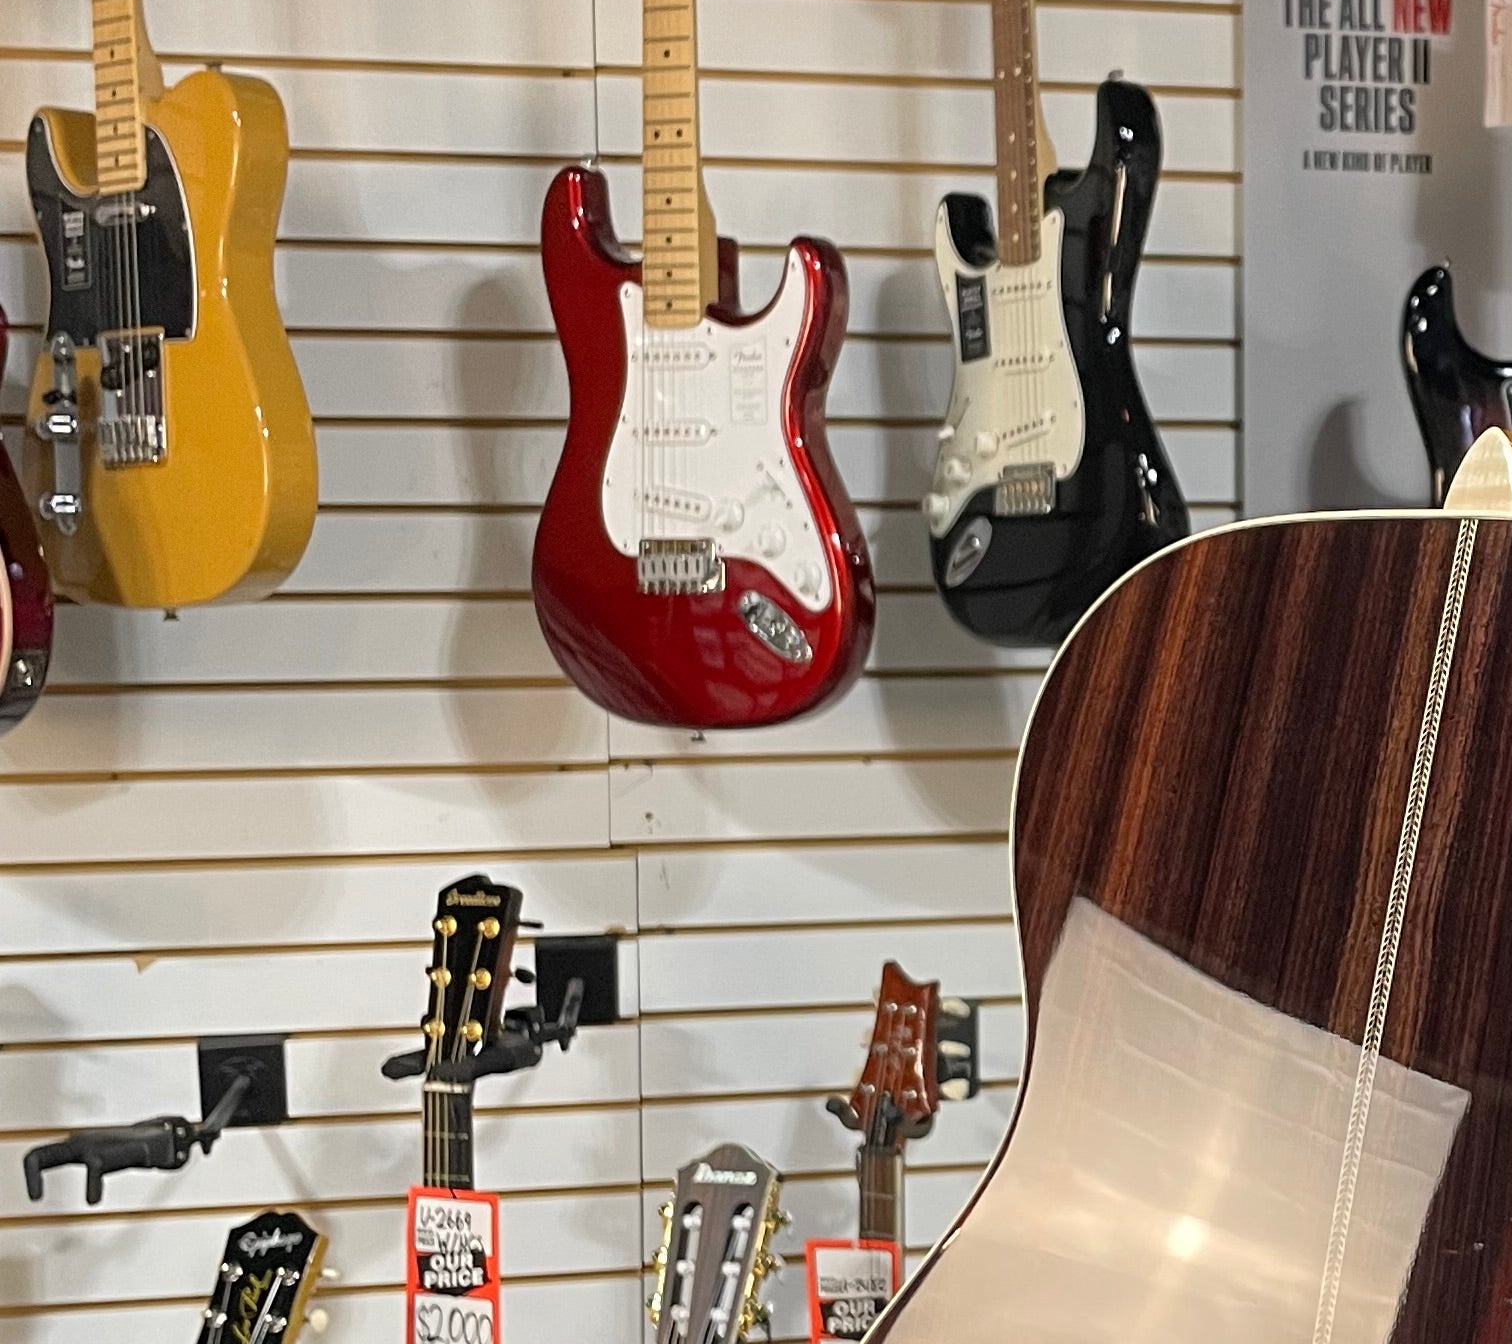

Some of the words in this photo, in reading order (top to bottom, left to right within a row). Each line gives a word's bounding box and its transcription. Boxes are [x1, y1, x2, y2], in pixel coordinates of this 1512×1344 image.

[1304, 33, 1402, 82] PLAYER
[1411, 38, 1431, 84] II
[1319, 86, 1417, 135] SERIES
[430, 1252, 473, 1272] OUR
[423, 1267, 484, 1289] PRICE
[832, 1299, 876, 1318] OUR
[826, 1316, 877, 1335] PRIC
